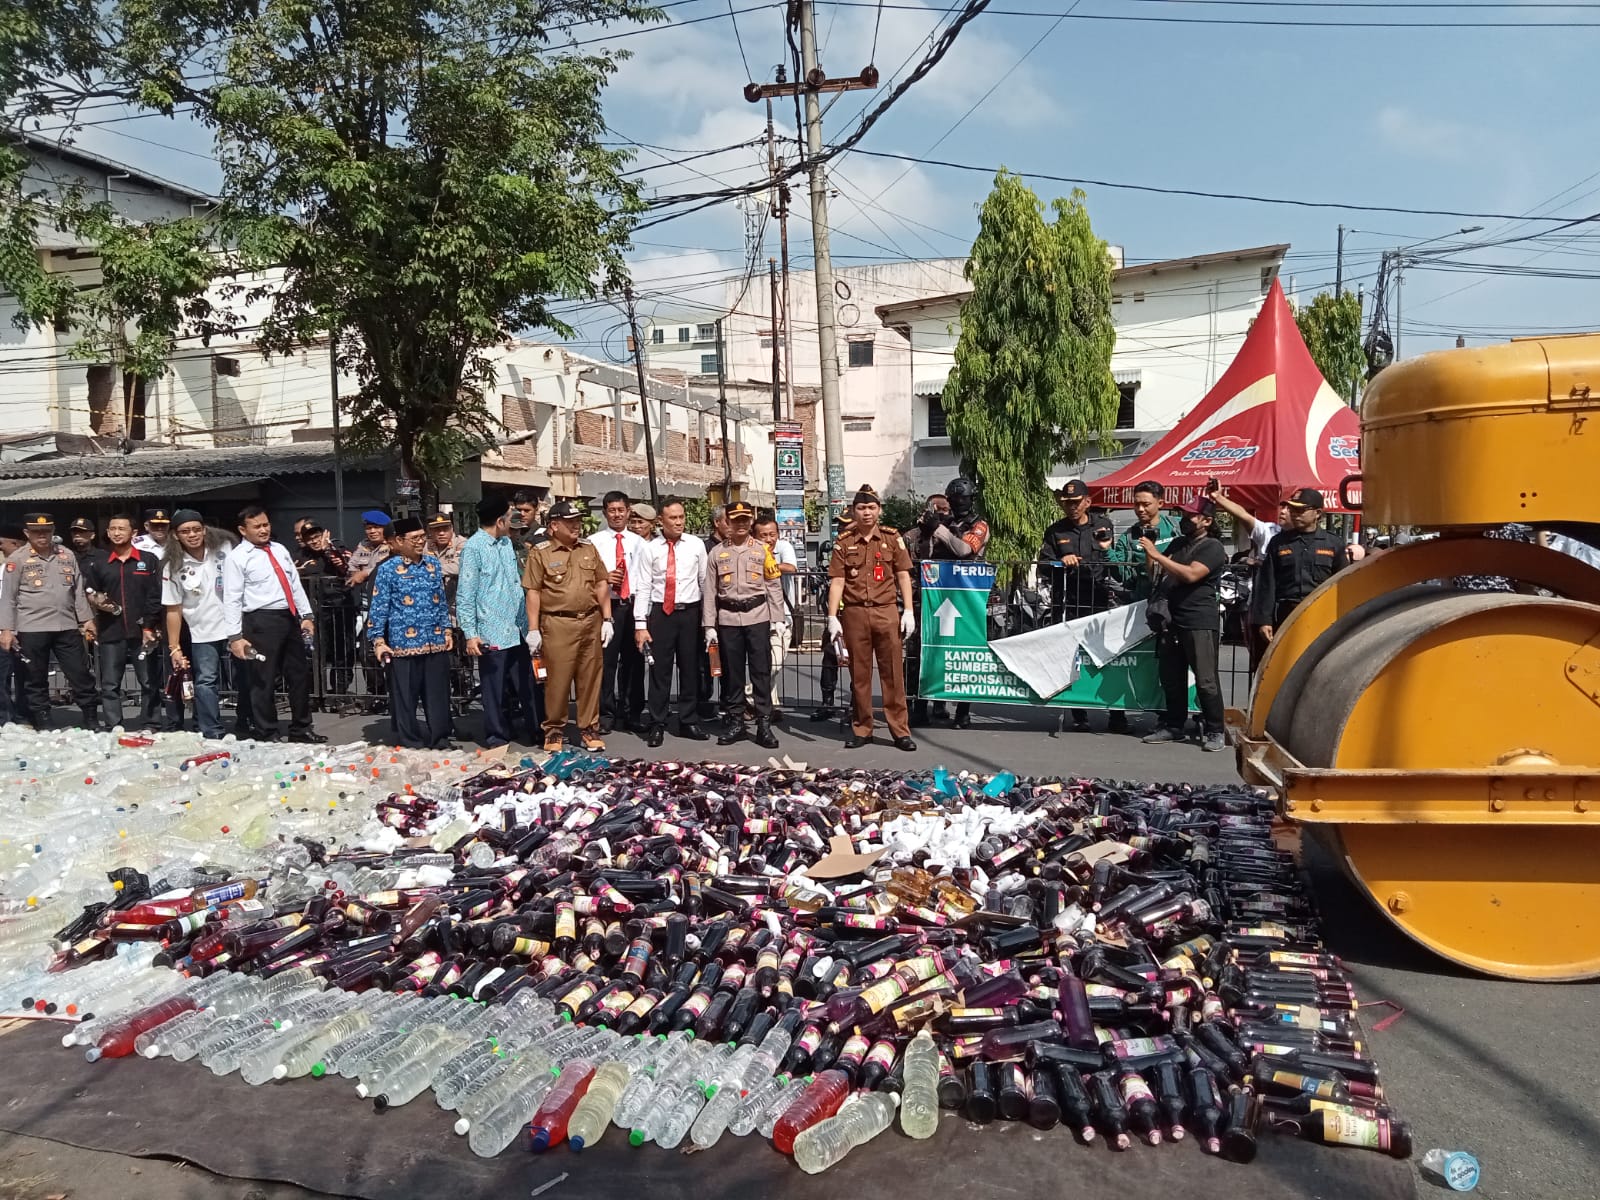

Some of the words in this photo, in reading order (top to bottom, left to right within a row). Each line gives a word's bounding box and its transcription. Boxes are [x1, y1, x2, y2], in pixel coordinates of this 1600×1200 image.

[1181, 445, 1260, 462] Sedaap
[1102, 486, 1119, 504] THE
[944, 650, 993, 662] KANTOR
[945, 661, 1009, 673] SUMBERS
[944, 672, 1017, 686] KEBONSARI
[944, 683, 1030, 698] BANYUWANGI
